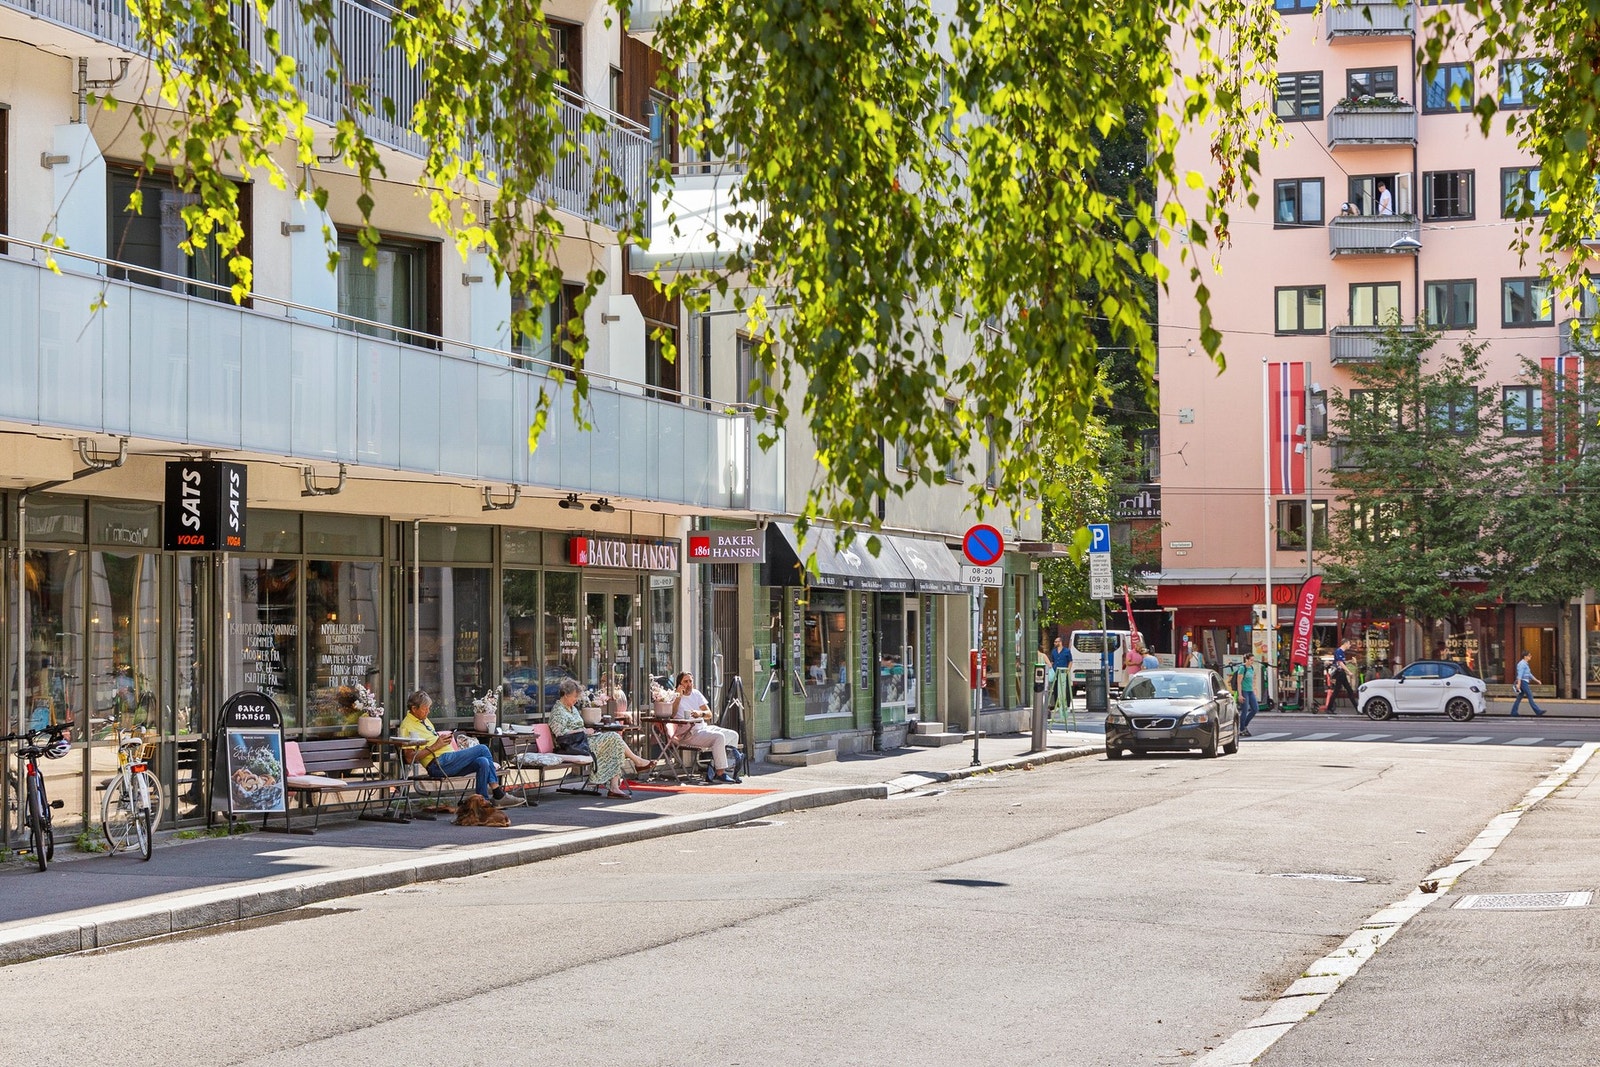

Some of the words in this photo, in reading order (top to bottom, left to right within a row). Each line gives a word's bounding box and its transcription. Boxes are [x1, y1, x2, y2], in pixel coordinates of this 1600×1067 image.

[182, 468, 200, 531] SATS
[230, 469, 240, 532] SATS
[178, 536, 204, 544] YOGA
[227, 536, 240, 547] YOGA
[718, 536, 754, 546] BAKER
[1092, 528, 1104, 550] P
[589, 540, 628, 567] BAKER
[632, 543, 678, 570] HANSEN
[694, 546, 710, 556] 1861
[713, 548, 760, 558] HANSEN
[1301, 593, 1314, 615] Luca
[1295, 637, 1308, 657] Deli
